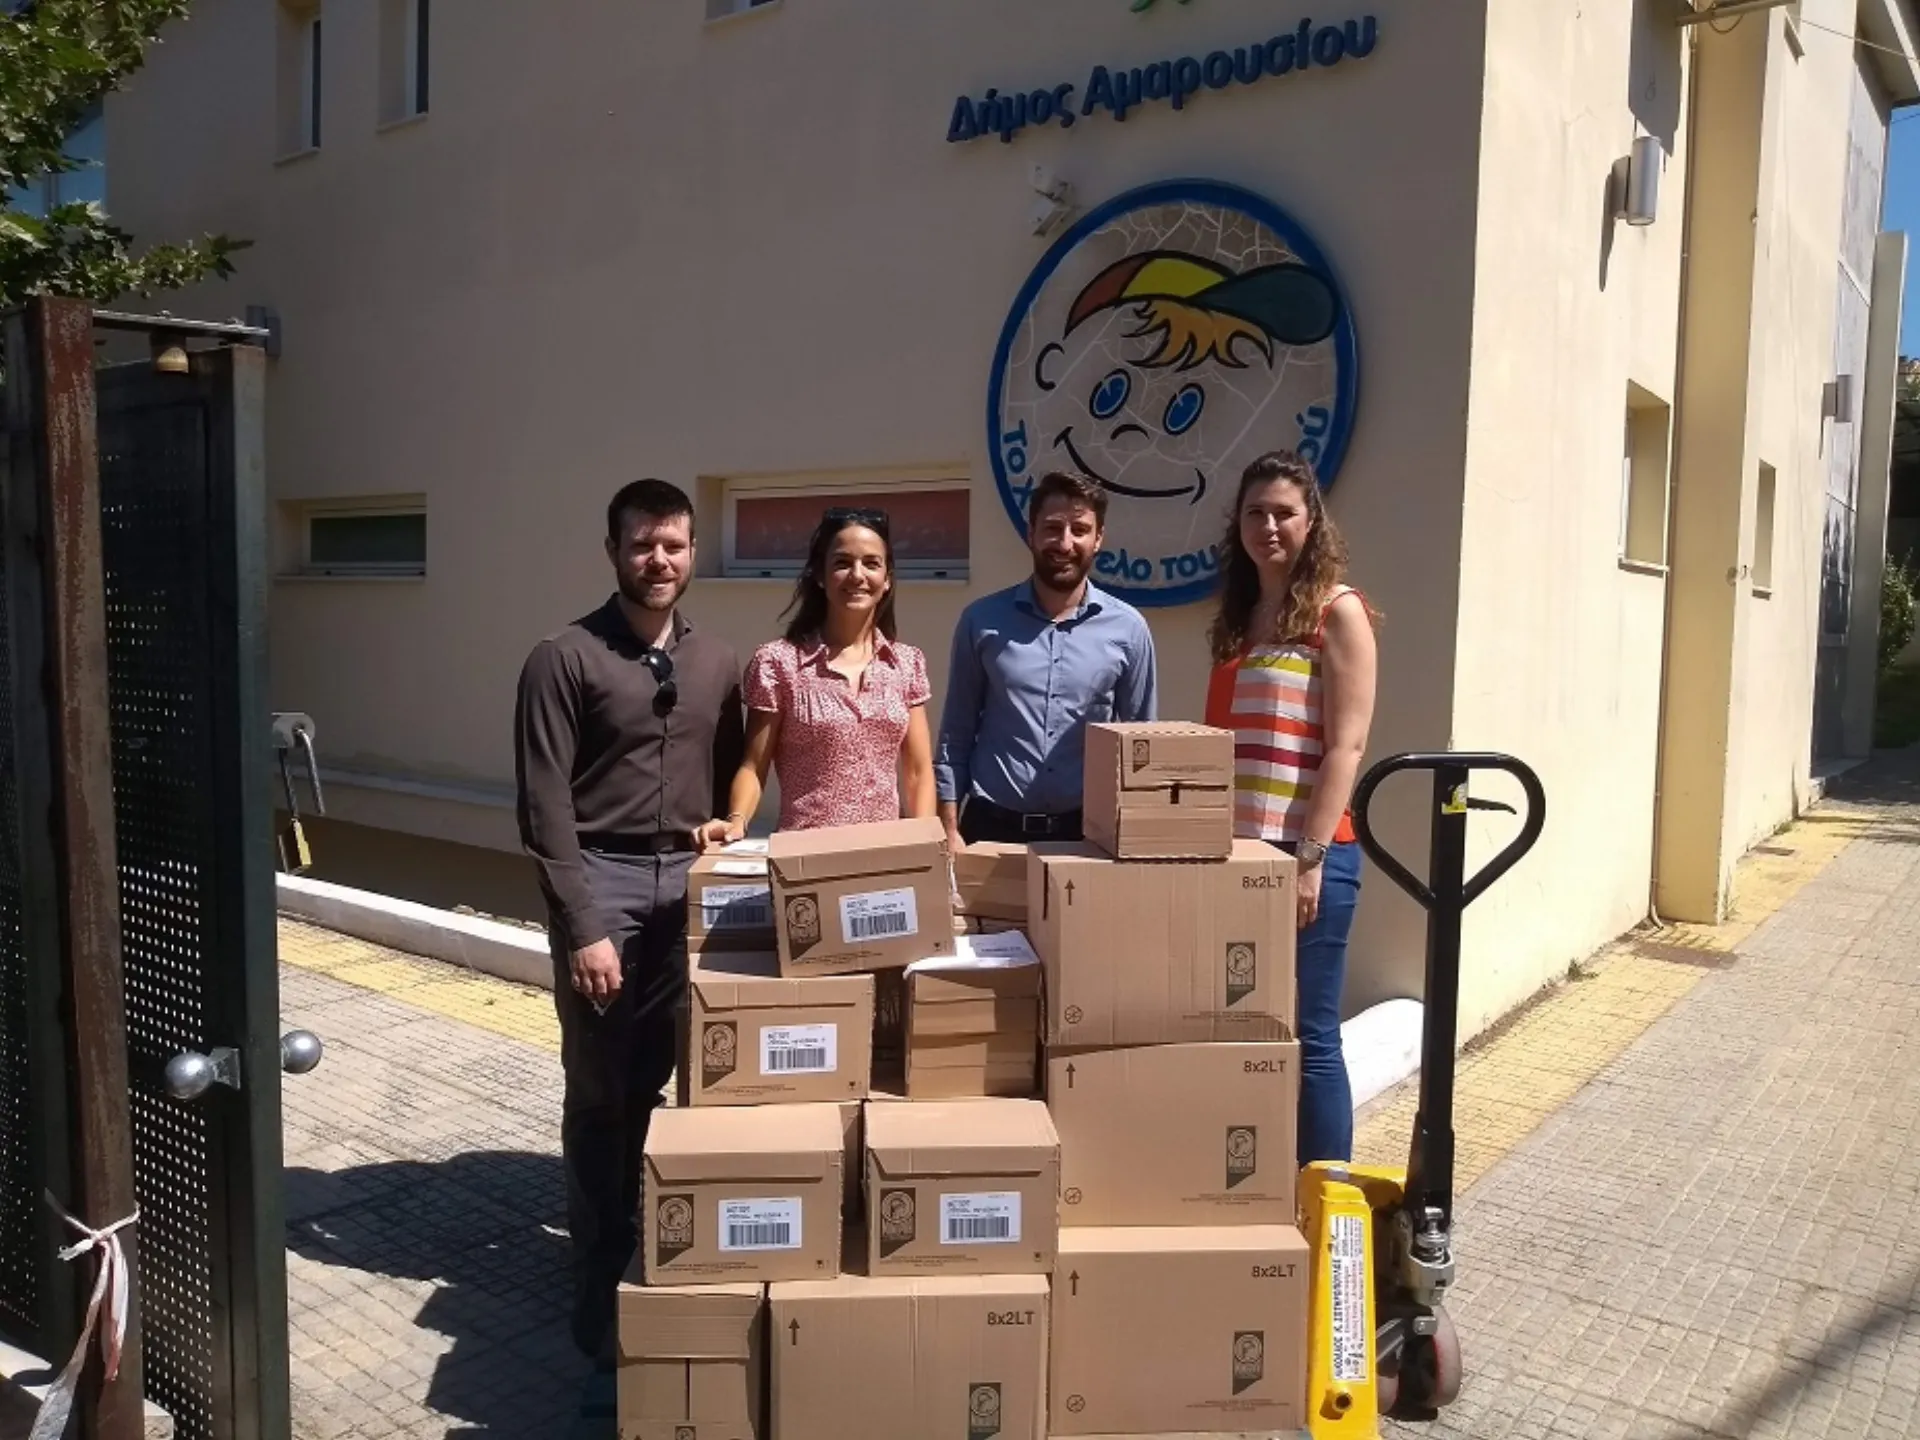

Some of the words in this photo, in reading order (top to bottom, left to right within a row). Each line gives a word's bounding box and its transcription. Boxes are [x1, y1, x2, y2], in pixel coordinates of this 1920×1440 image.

[946, 82, 1076, 143] Δήμος
[1081, 15, 1376, 122] Αμαρουσίου
[1241, 875, 1285, 889] 8x2LT
[1243, 1059, 1287, 1073] 8x2LT
[1251, 1263, 1296, 1278] 8x2LT
[987, 1310, 1035, 1325] 8x2LT
